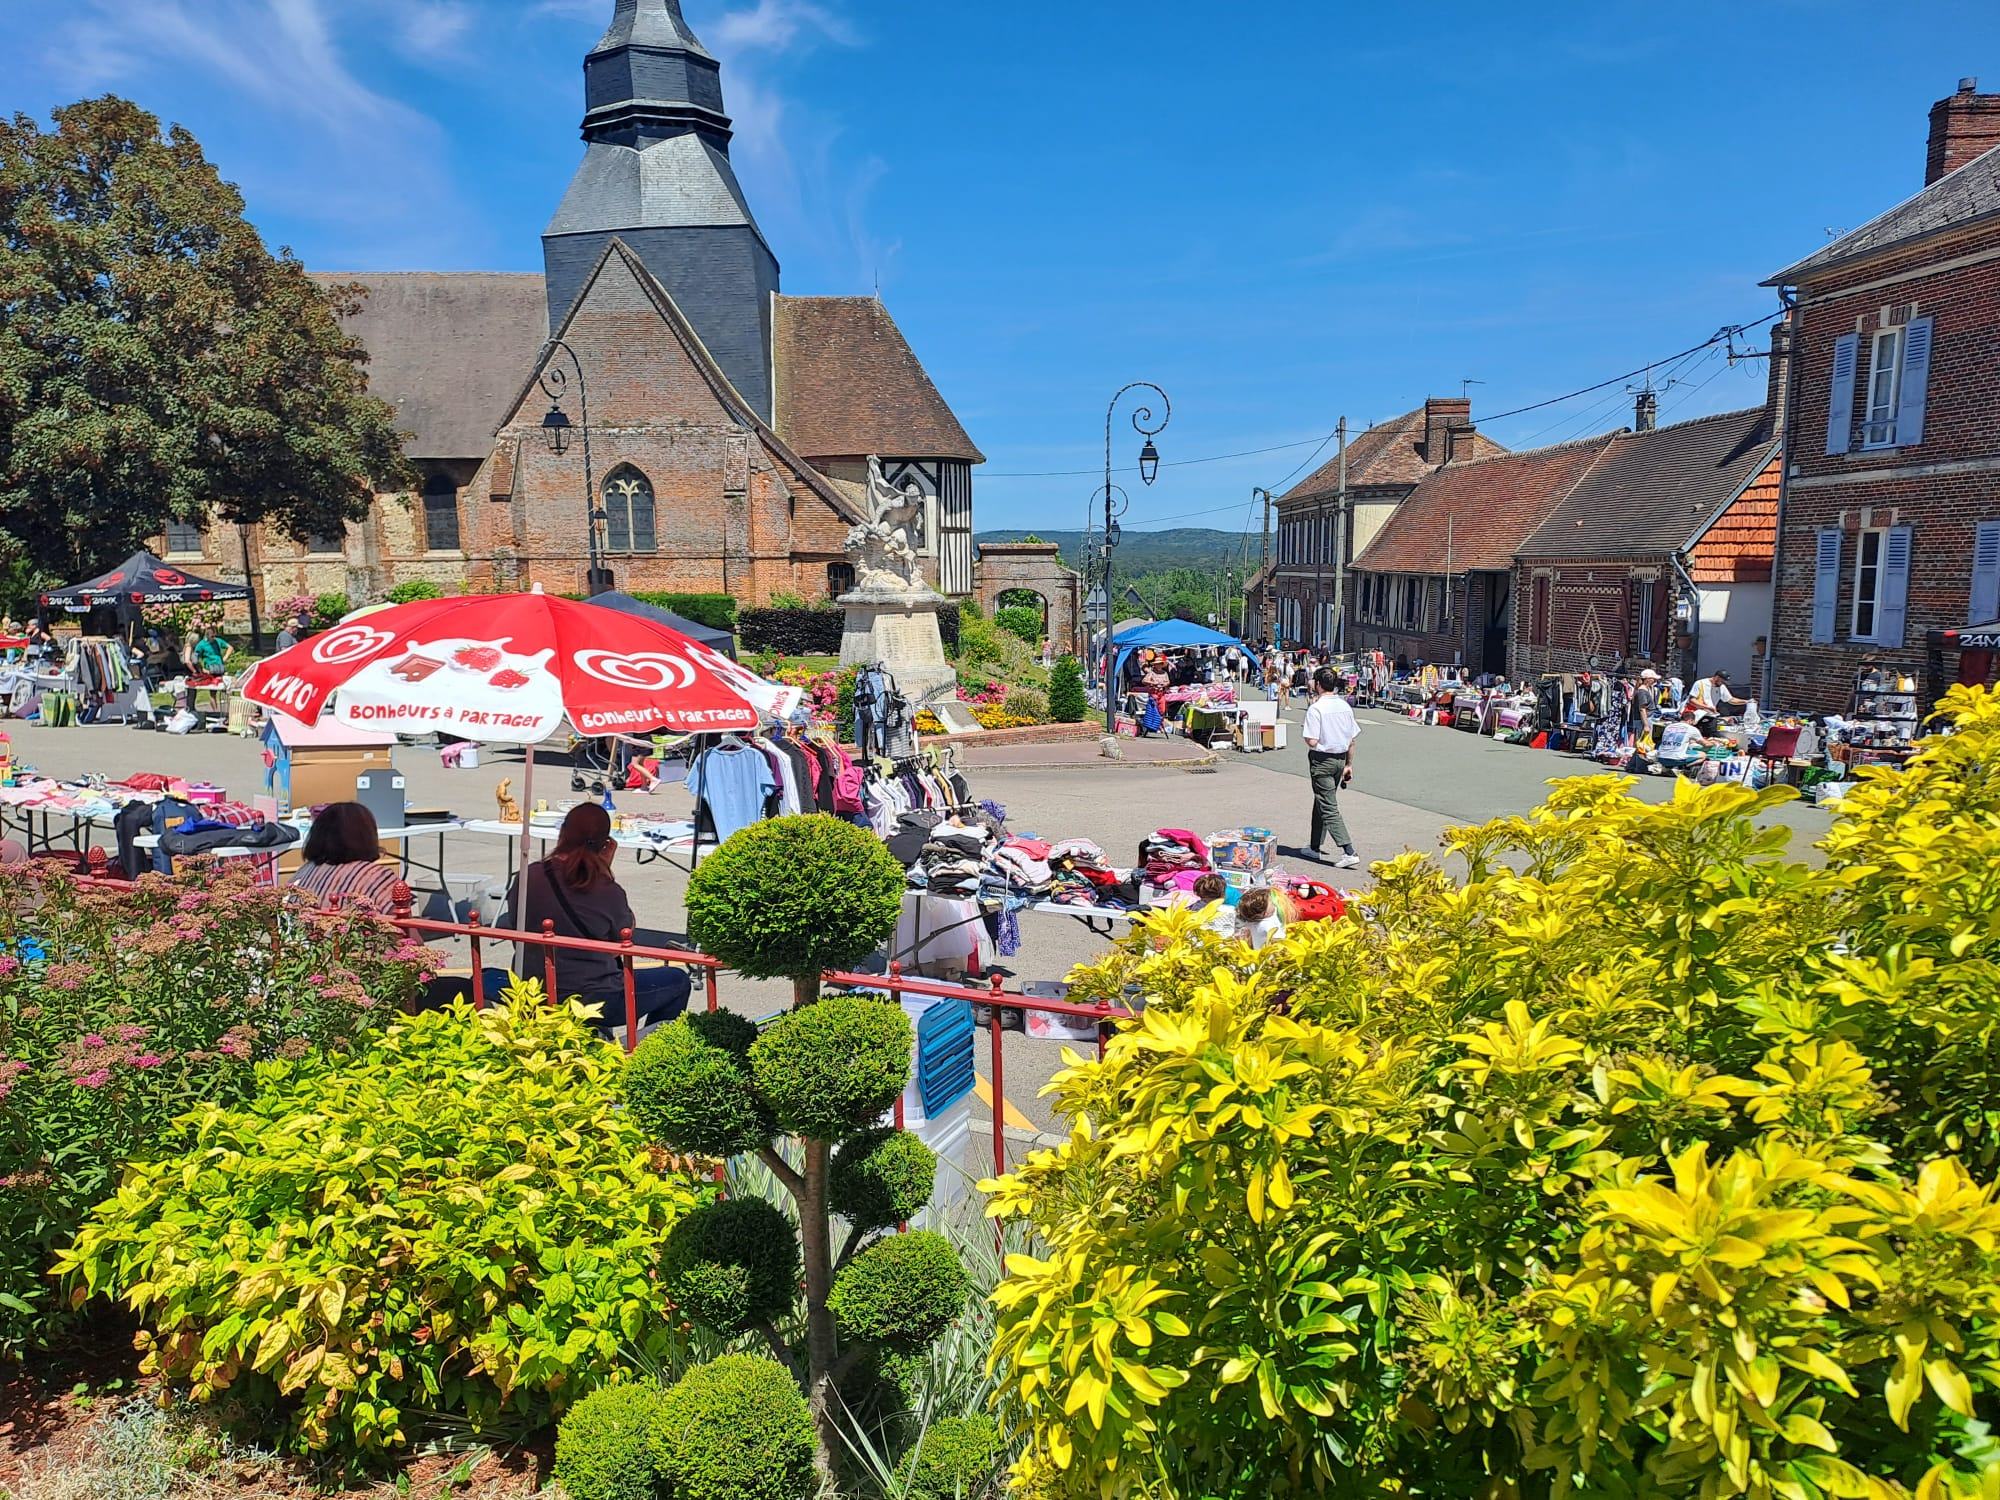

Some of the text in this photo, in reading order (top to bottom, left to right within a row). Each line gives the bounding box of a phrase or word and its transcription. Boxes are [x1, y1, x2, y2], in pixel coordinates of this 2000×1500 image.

[145, 593, 183, 602] 24MX
[260, 672, 314, 712] MKO
[350, 704, 441, 720] Bonheurs
[581, 707, 663, 728] Bonheurs
